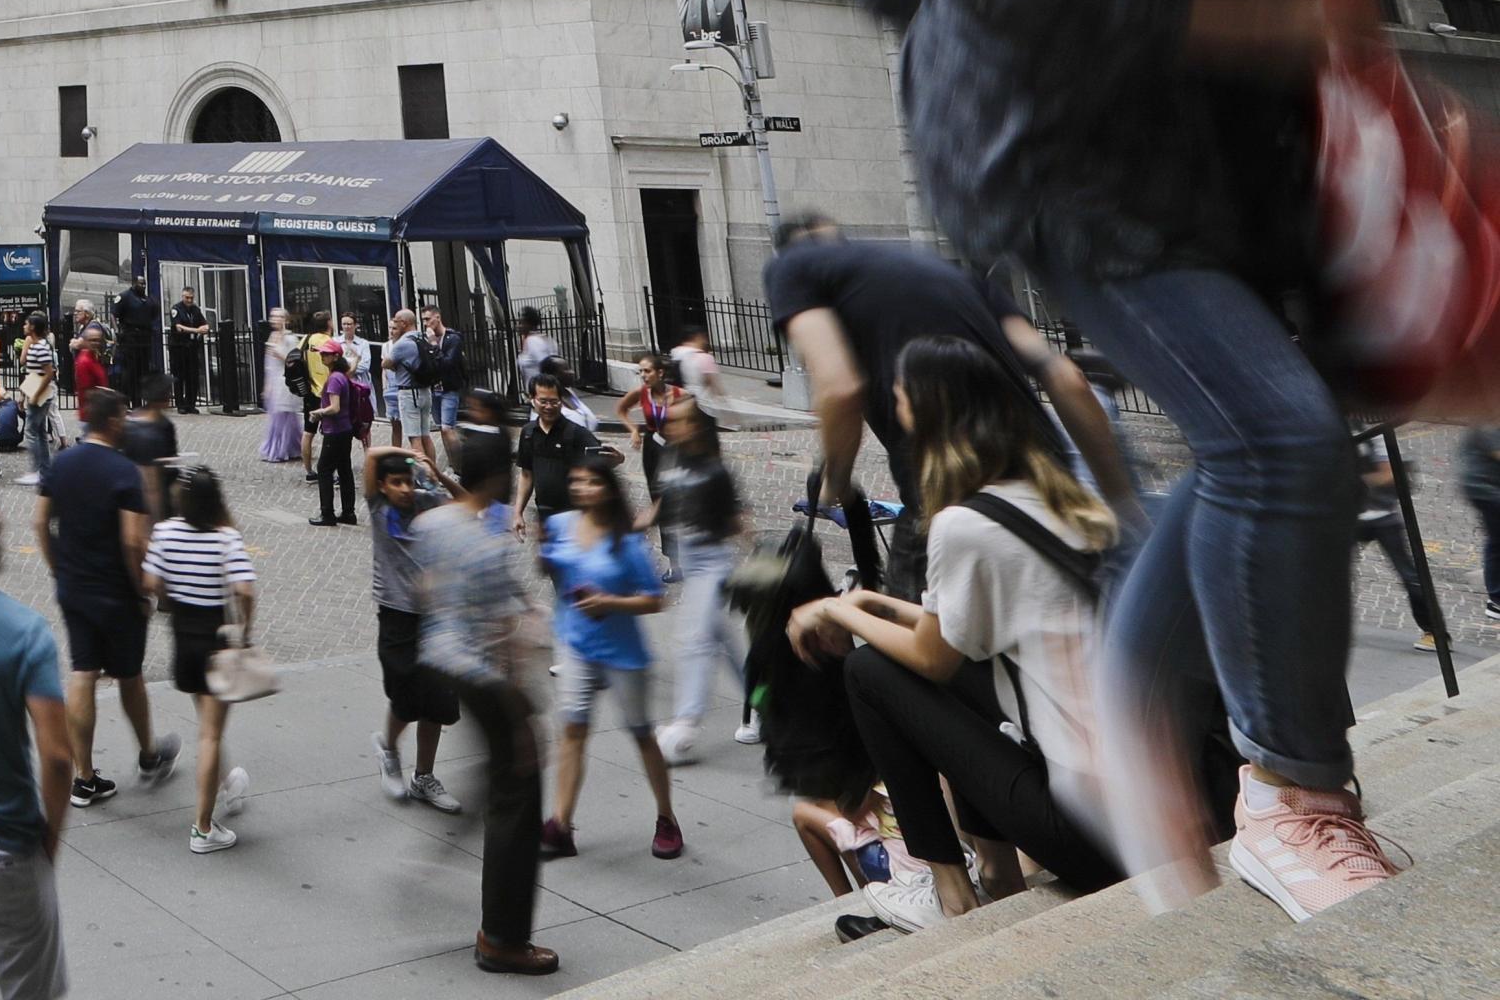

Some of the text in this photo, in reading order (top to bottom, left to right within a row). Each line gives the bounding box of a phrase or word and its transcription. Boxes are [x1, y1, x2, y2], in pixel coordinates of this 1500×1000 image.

[701, 29, 721, 42] bgc
[775, 119, 795, 130] WALL
[701, 135, 733, 146] BROAD
[130, 171, 376, 188] NEW YORK STOCK EXCHANGE
[130, 191, 178, 200] FOLLOW
[154, 216, 241, 228] EMPLOYEE ENTRANCE
[273, 218, 376, 232] REGISTERED GUESTS
